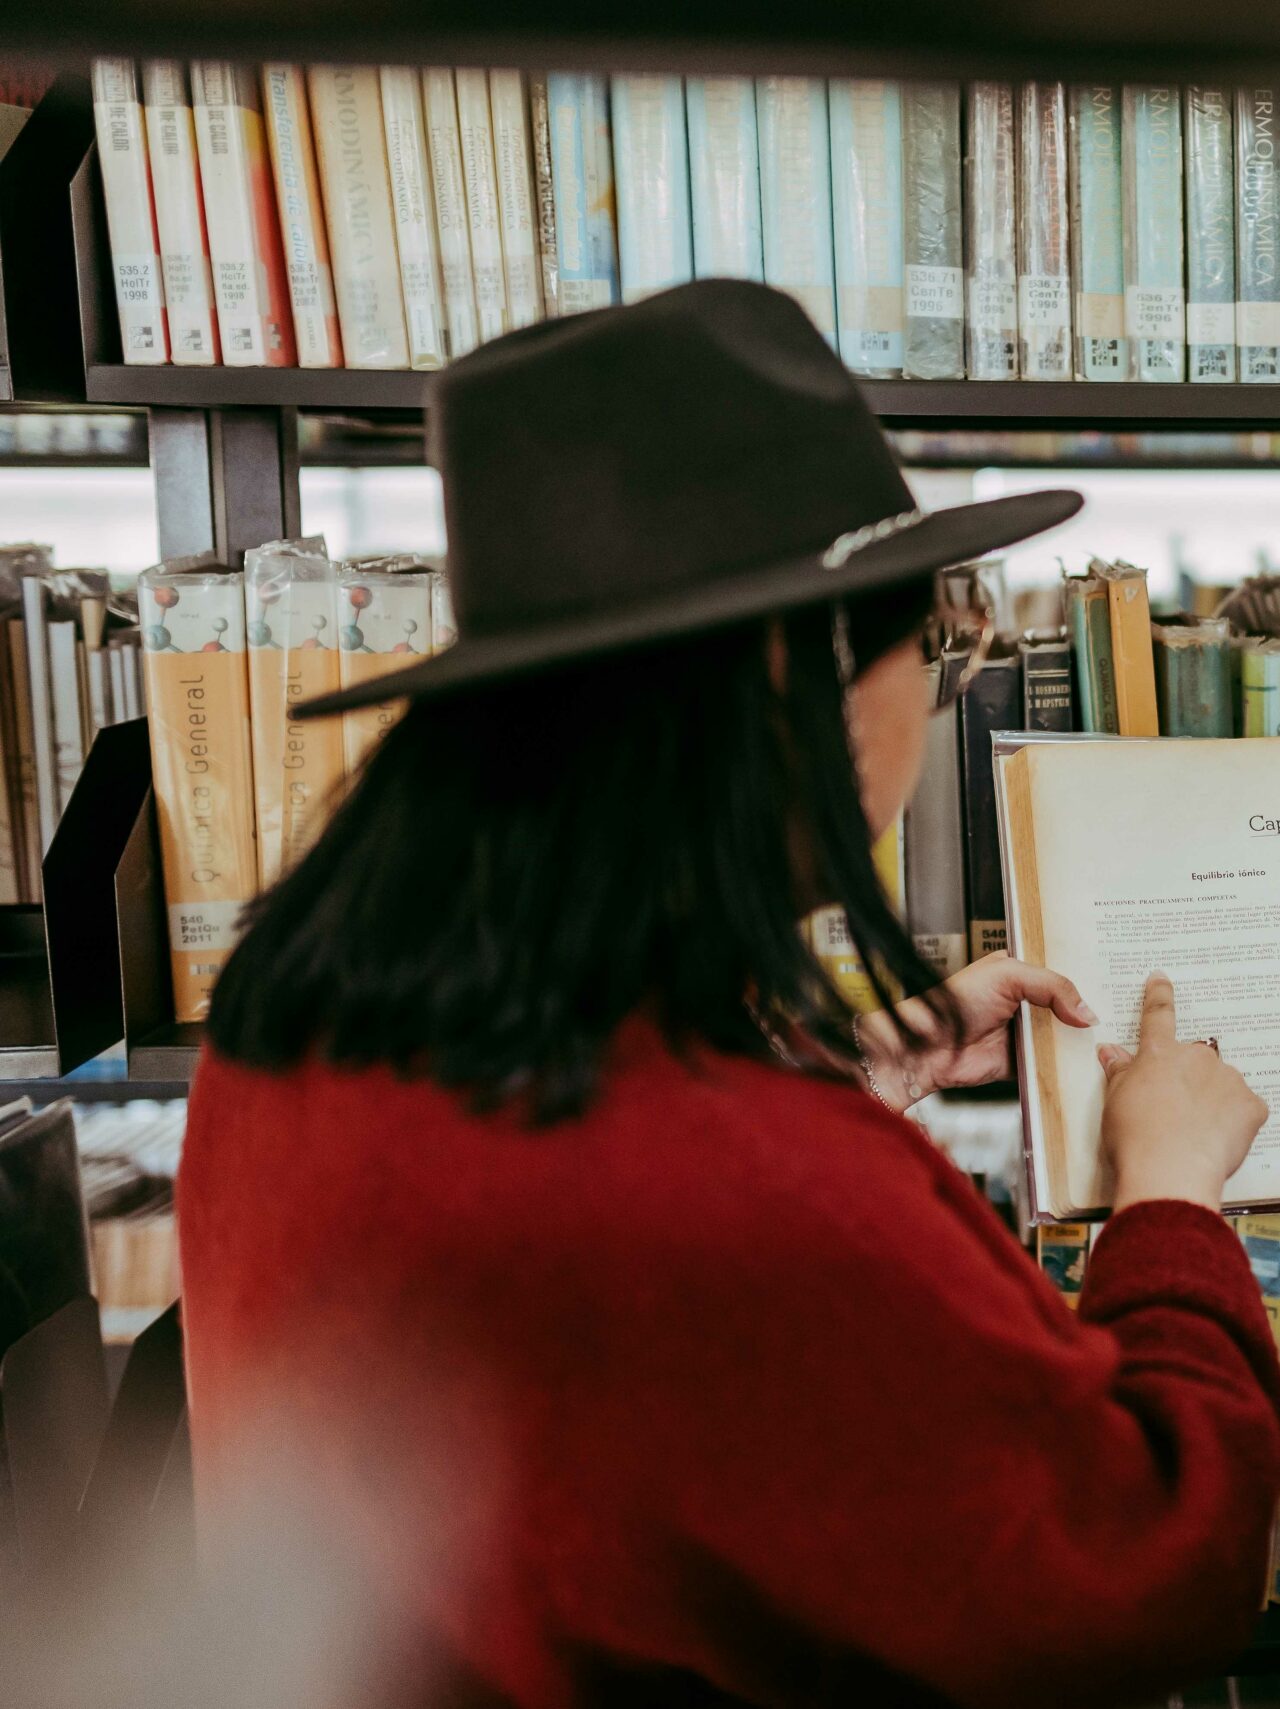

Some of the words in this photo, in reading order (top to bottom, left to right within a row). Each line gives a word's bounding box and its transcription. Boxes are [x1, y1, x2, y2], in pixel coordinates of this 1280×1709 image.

[110, 121, 129, 151] CALOR
[124, 290, 148, 300] 1998
[912, 301, 944, 312] 1996
[180, 675, 209, 774] General
[1191, 870, 1235, 882] Equilibrio
[1238, 869, 1266, 878] iónico
[1094, 899, 1136, 907] REACCIONES
[1139, 896, 1194, 905] PRACTICAMENTE
[1197, 894, 1238, 903] COMPLETAS
[182, 934, 212, 944] 2011
